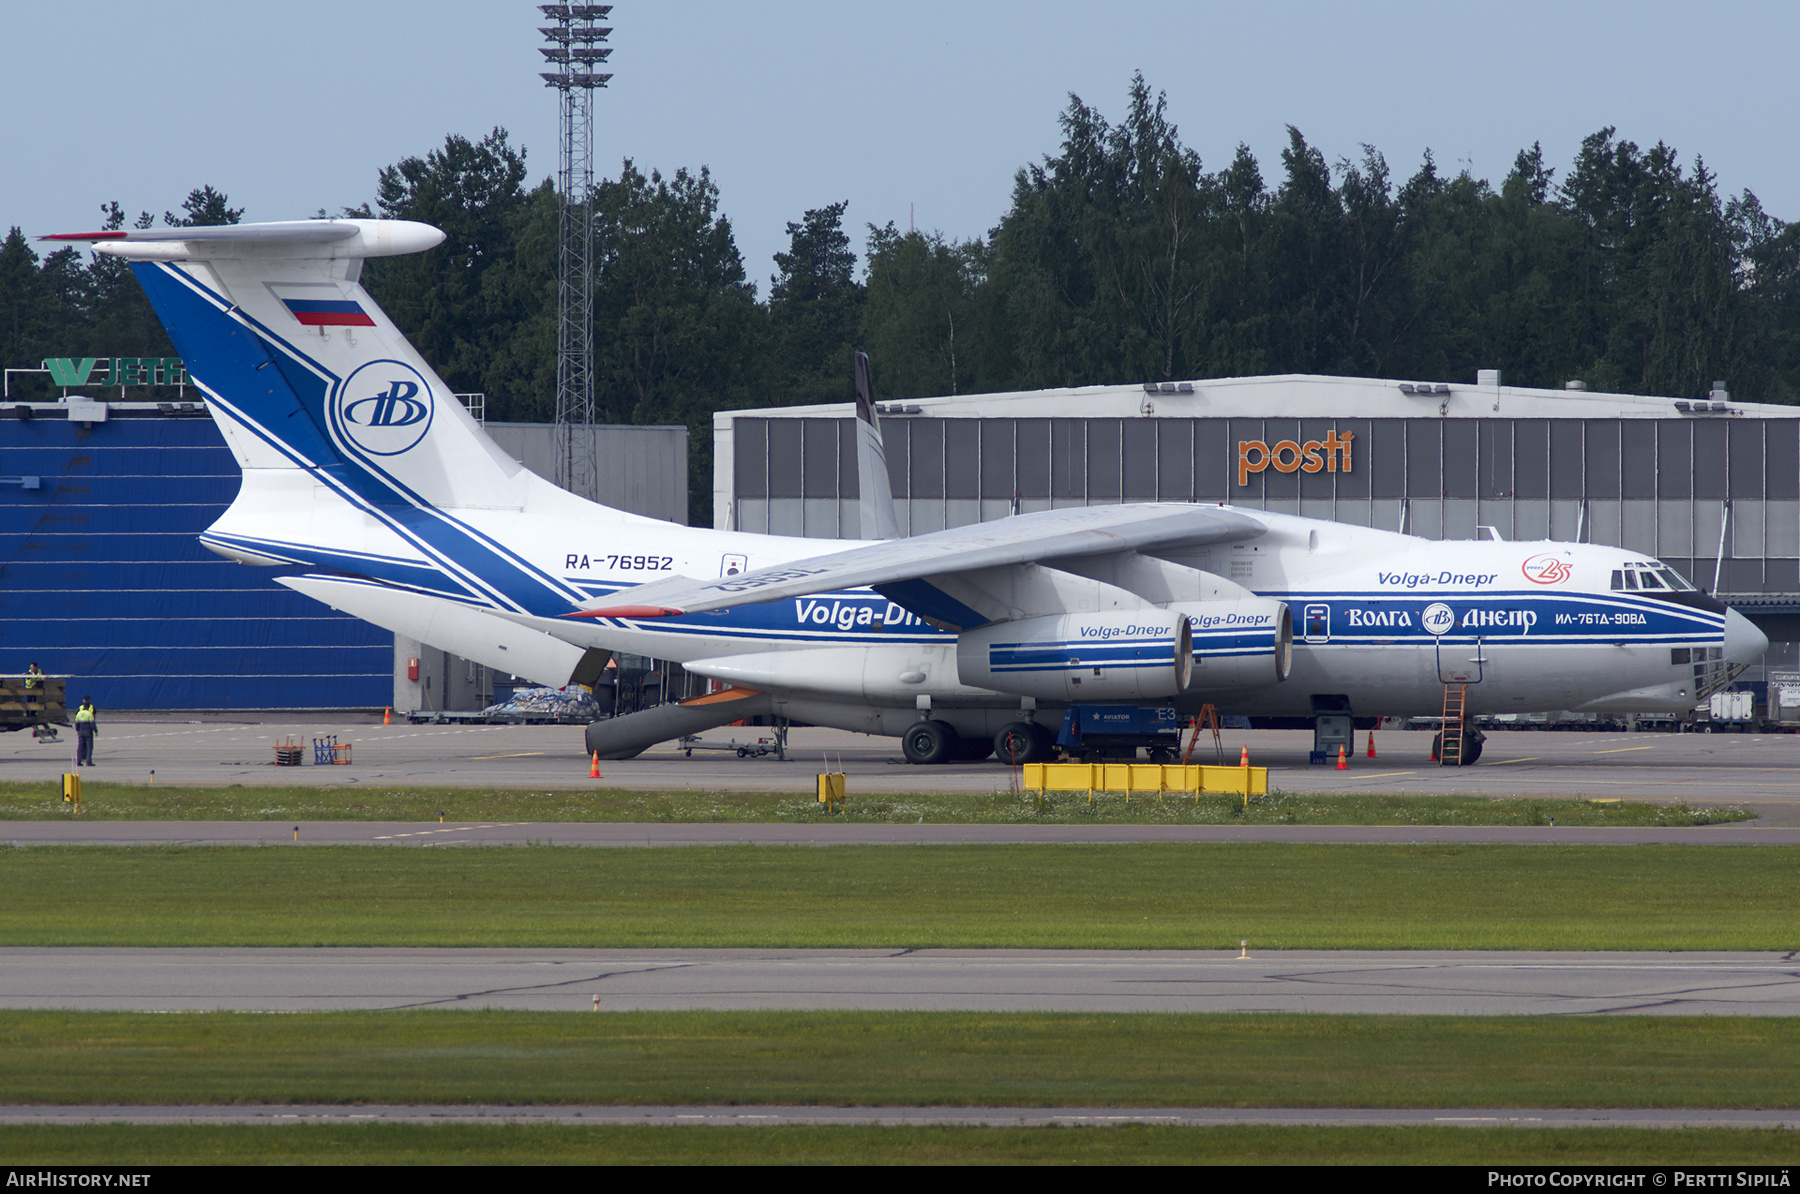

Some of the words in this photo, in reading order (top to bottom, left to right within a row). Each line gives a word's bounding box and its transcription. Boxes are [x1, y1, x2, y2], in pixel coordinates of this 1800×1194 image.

[101, 358, 195, 386] JETF
[1238, 430, 1354, 486] posti
[565, 554, 674, 570] RA-76952
[1538, 558, 1573, 584] 25
[1378, 571, 1498, 588] Volga-Dnepr
[1187, 613, 1271, 628] olga-Dnepr
[1080, 624, 1171, 639] Volga-Dnepr
[1158, 707, 1176, 720] E3
